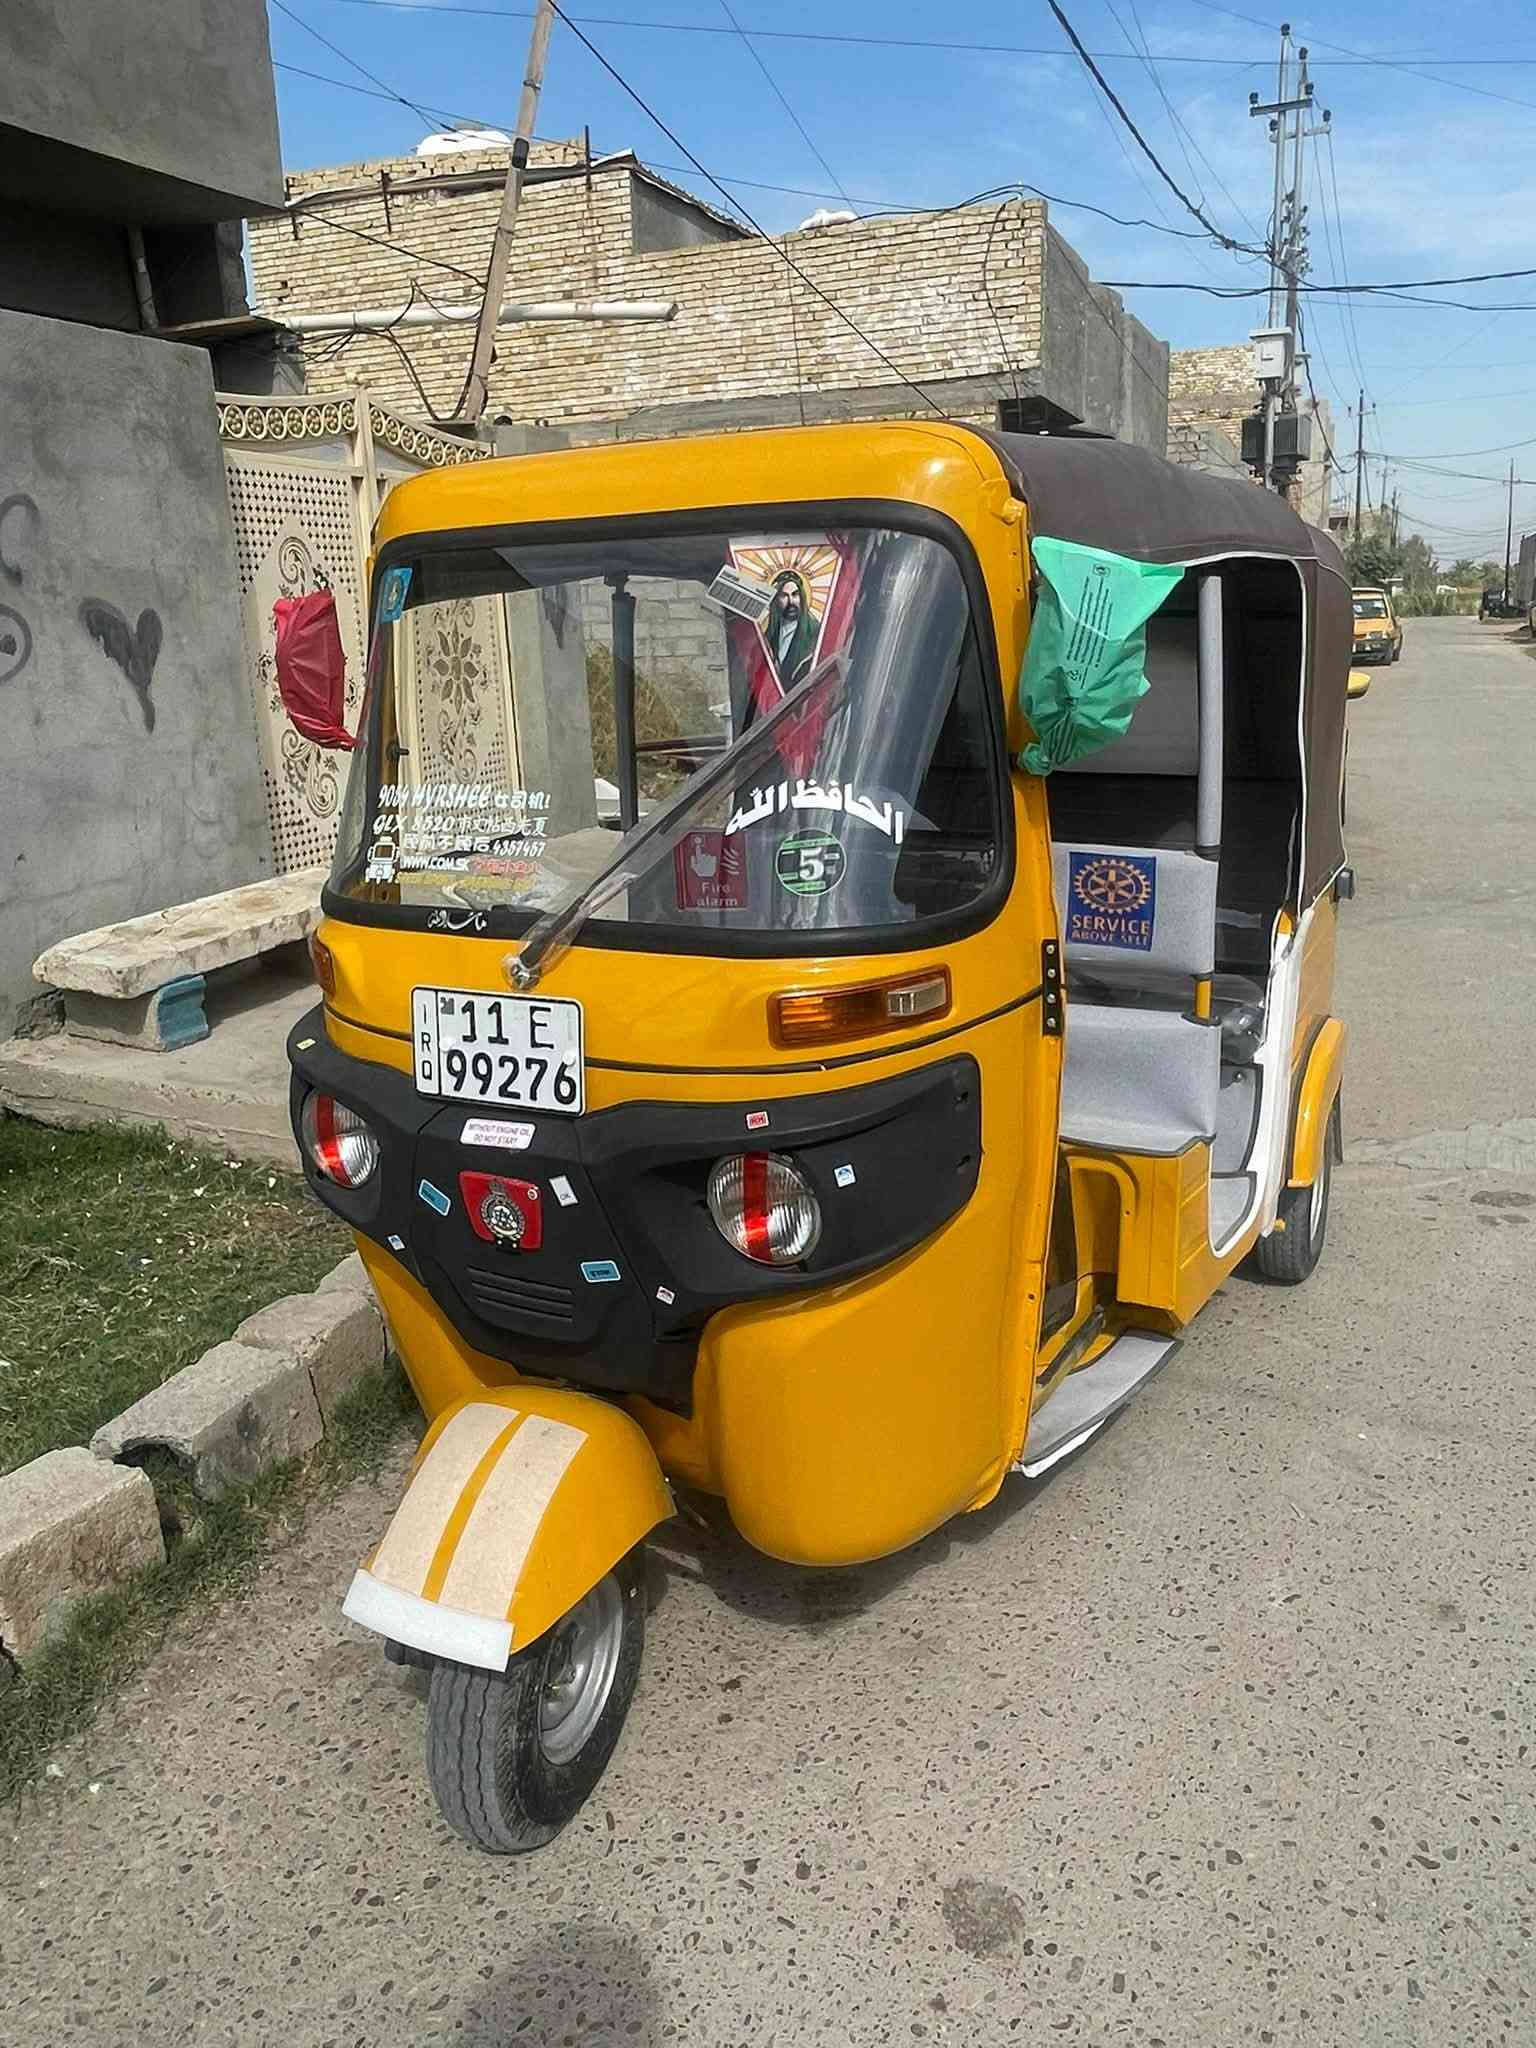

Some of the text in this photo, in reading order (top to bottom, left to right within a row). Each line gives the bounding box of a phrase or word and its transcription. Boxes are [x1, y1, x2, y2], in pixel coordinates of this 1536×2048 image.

[725, 779, 903, 844] الحافظ الله
[701, 881, 731, 895] Fire
[696, 896, 738, 907] alarm
[1071, 914, 1151, 936] SERVICE
[1071, 929, 1114, 943] ABOVE
[461, 1000, 555, 1049] 11 E
[446, 1048, 577, 1105] 99276
